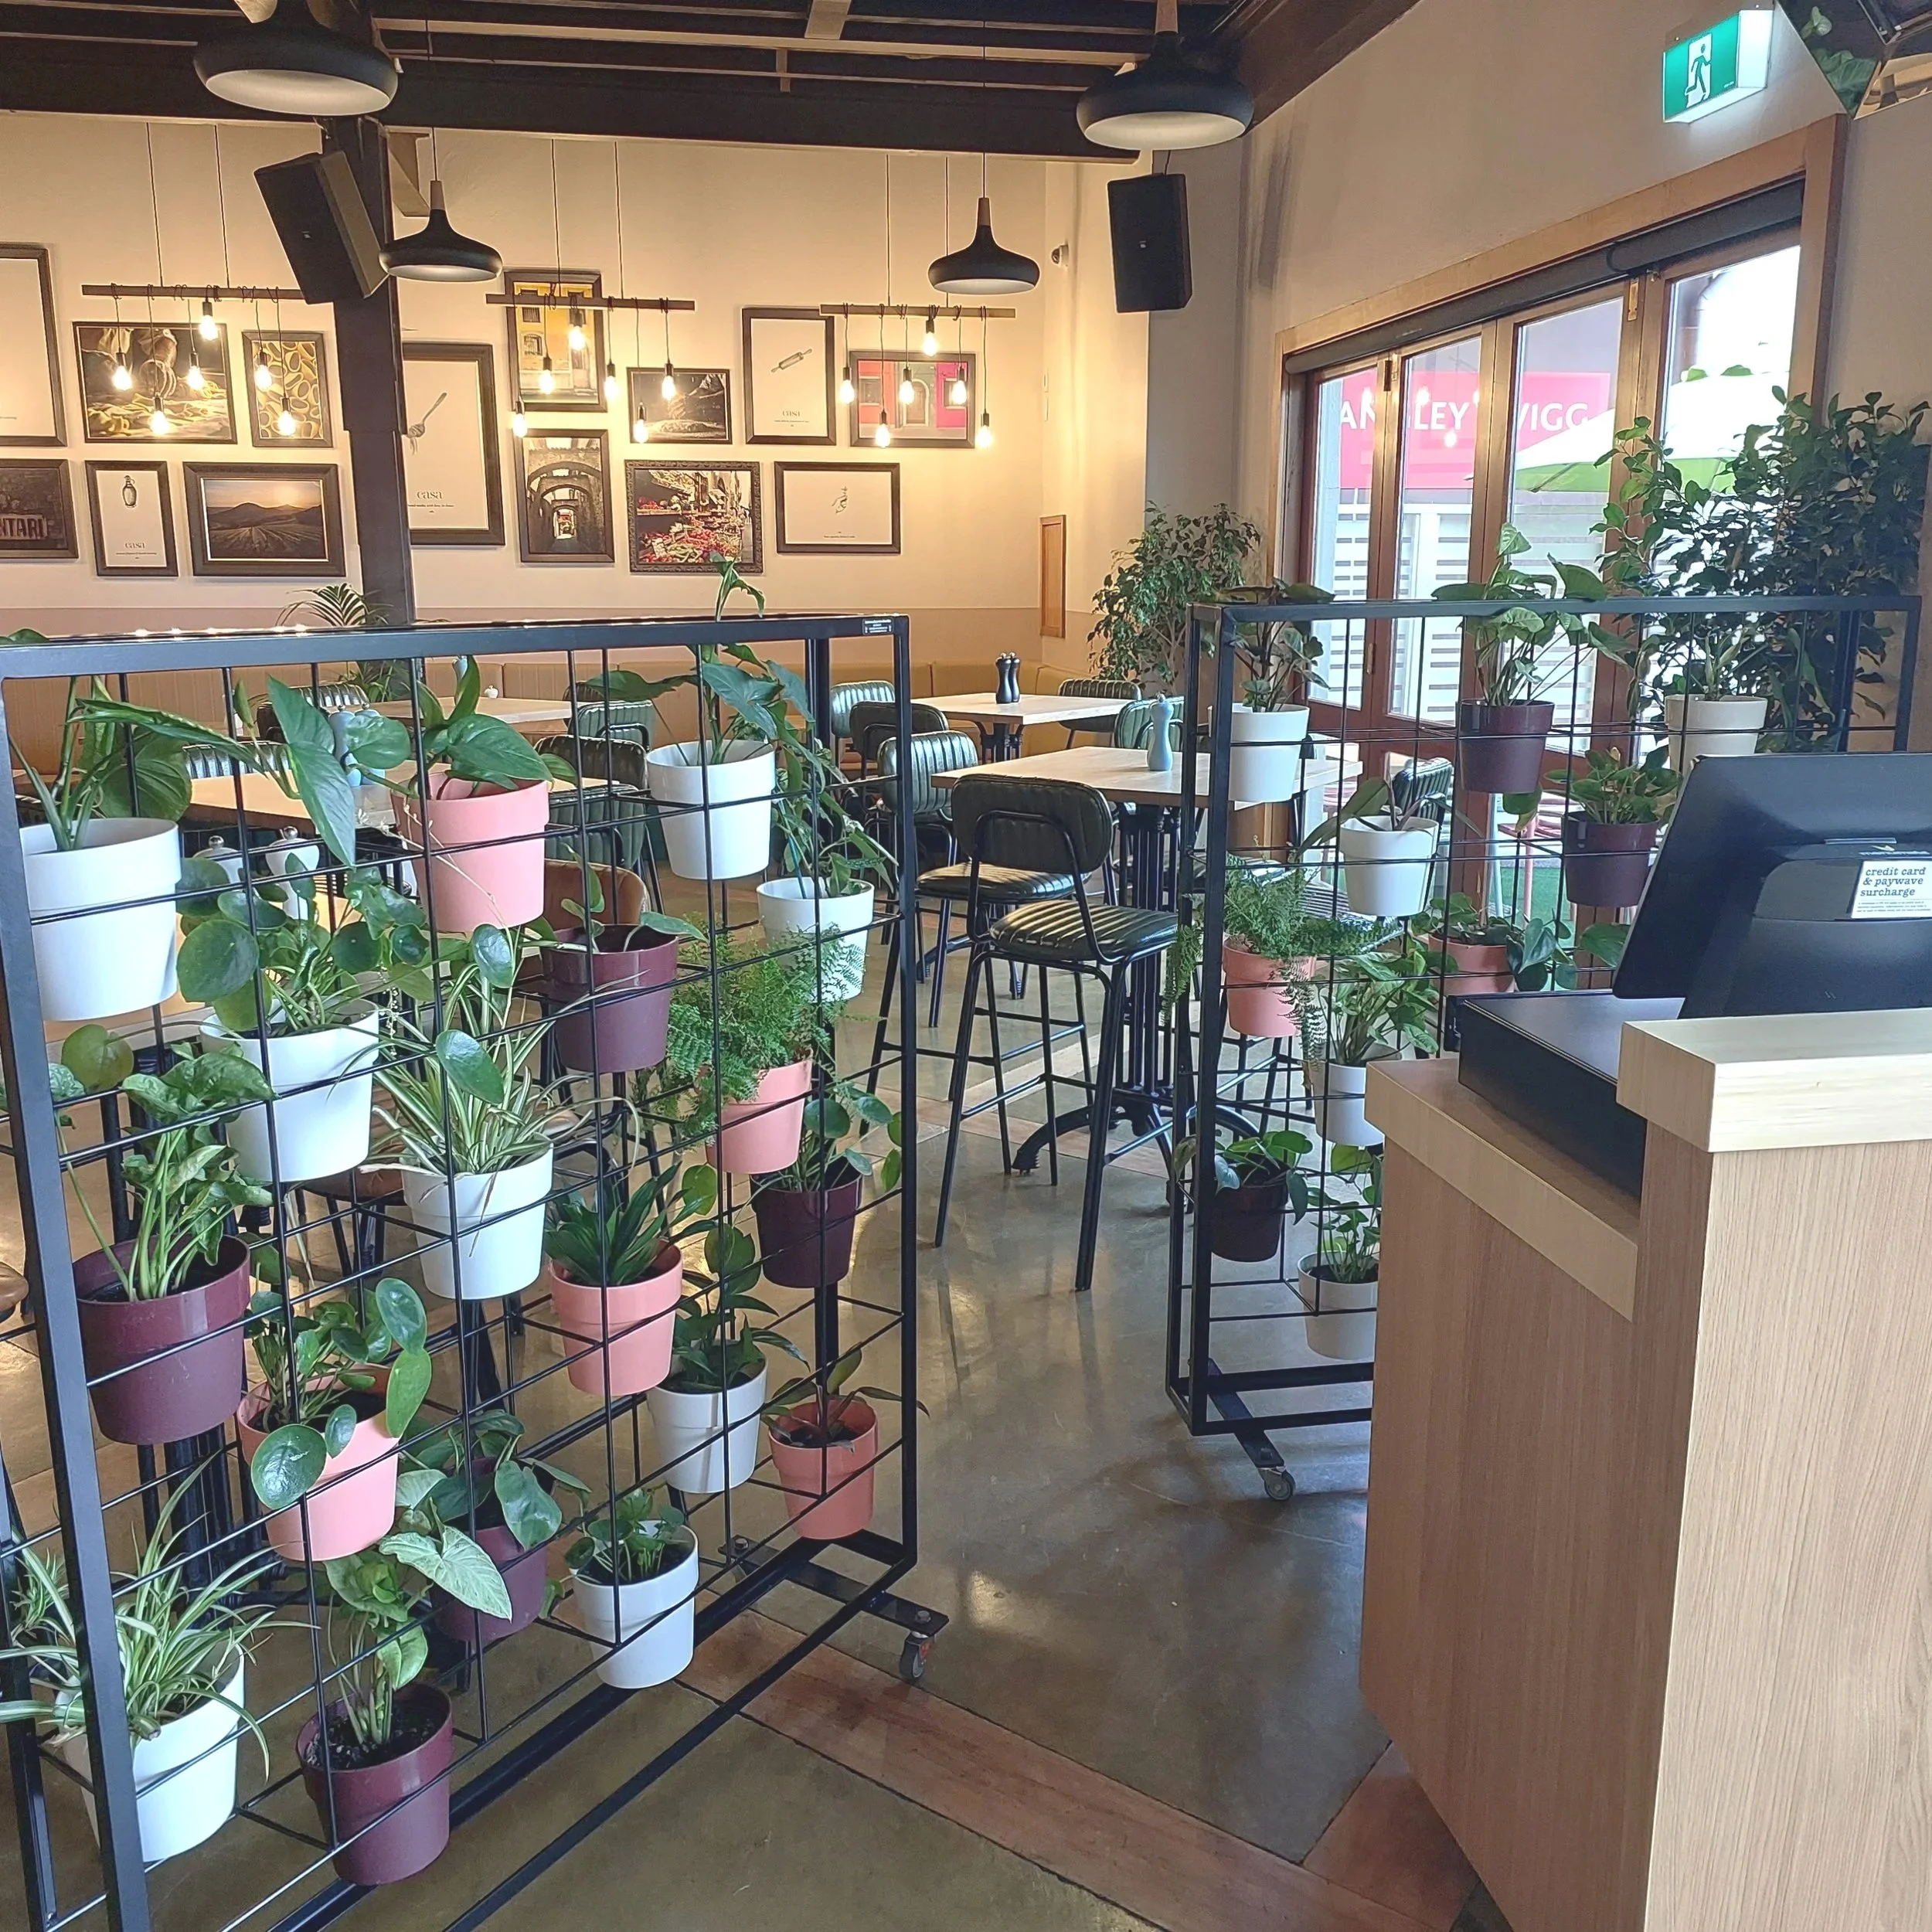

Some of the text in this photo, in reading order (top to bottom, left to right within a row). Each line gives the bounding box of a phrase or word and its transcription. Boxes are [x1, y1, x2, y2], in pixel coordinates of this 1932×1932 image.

[1340, 400, 1470, 430] ANLEY
[416, 491, 443, 500] casa
[1866, 866, 1927, 876] credit card
[1862, 877, 1923, 887] & paywave
[1860, 888, 1916, 898] surcharge
